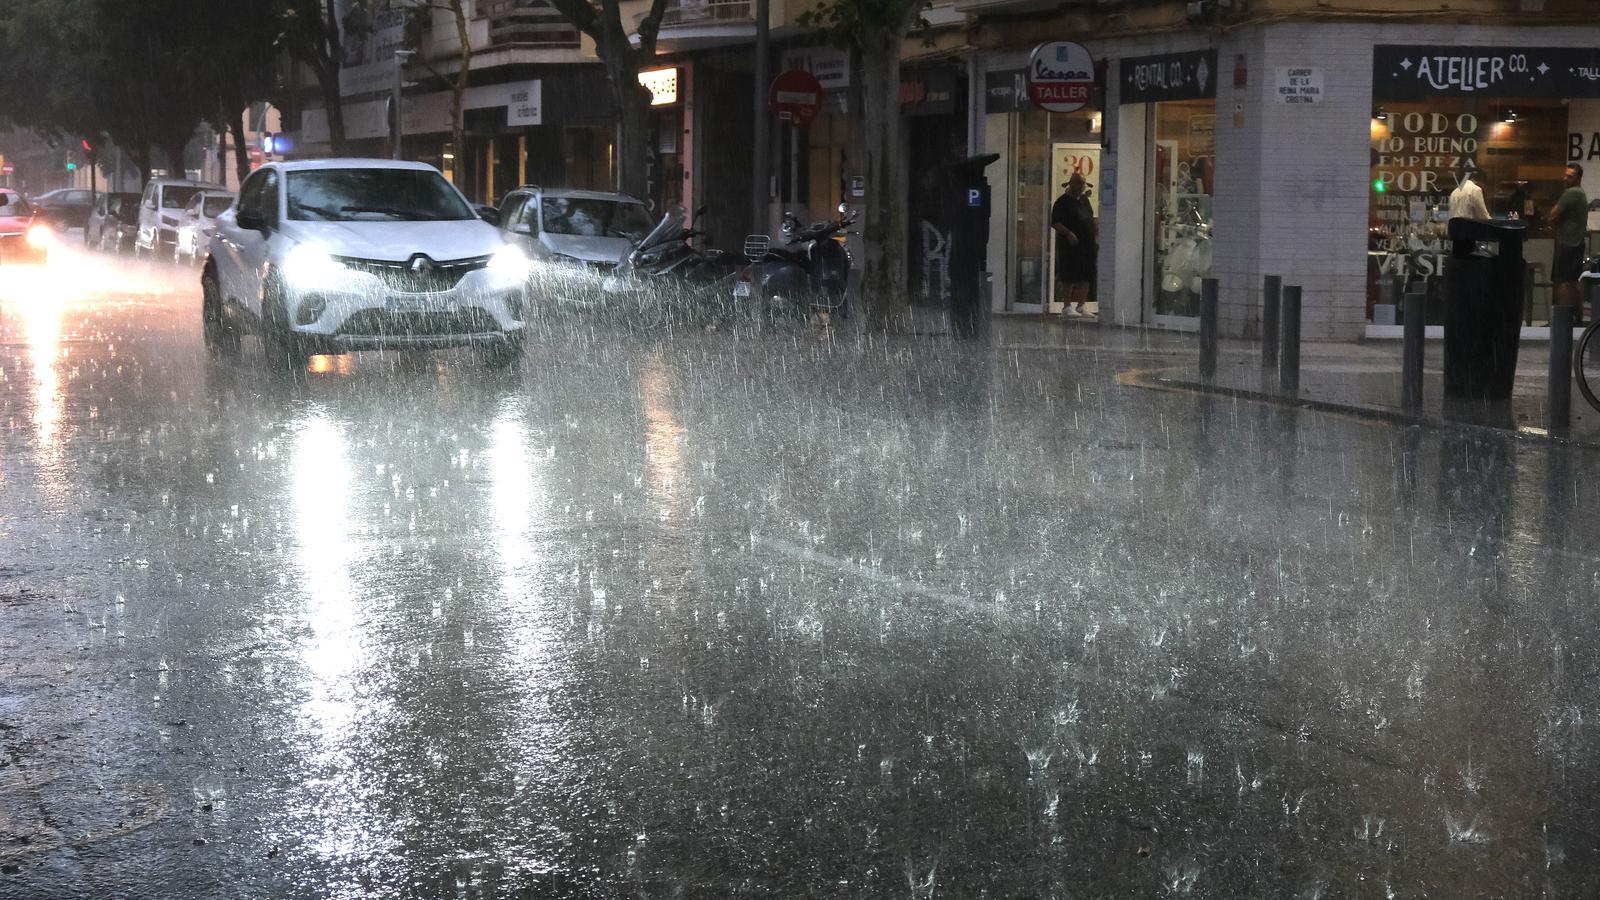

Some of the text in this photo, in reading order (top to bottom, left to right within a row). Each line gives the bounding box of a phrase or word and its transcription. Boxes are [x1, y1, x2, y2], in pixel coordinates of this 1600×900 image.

[1035, 58, 1091, 80] Vespa
[1135, 64, 1168, 91] RENTAL
[1417, 54, 1529, 91] ATELIER CO.
[1036, 86, 1088, 99] TALLER
[1381, 112, 1477, 134] TODO
[1379, 136, 1477, 153] LO BUENO
[1063, 155, 1094, 177] 30
[1380, 156, 1476, 168] EMPIEZA
[1379, 170, 1442, 193] POR
[969, 189, 979, 203] P
